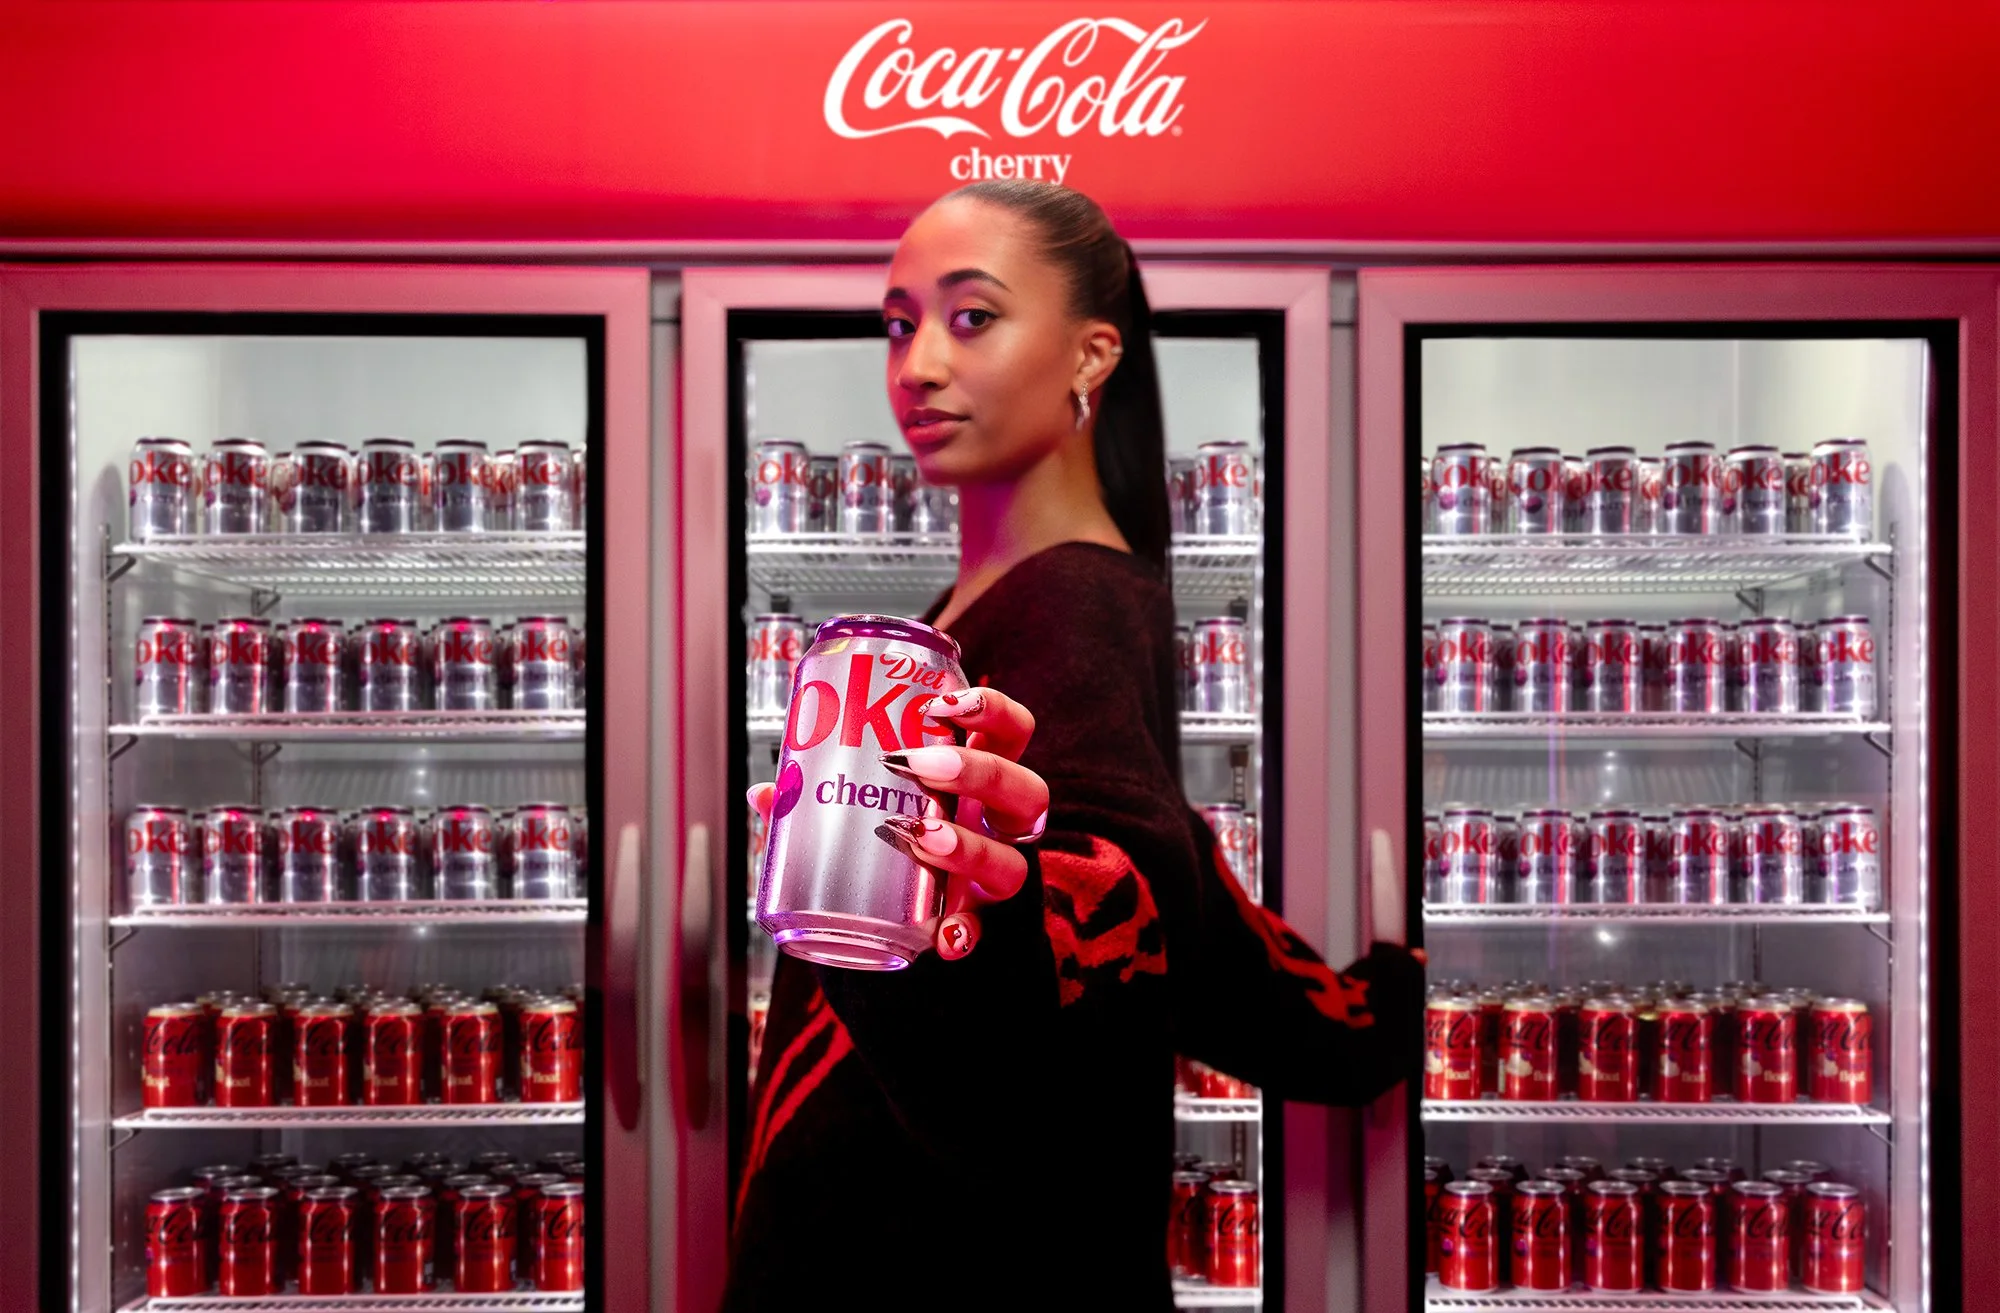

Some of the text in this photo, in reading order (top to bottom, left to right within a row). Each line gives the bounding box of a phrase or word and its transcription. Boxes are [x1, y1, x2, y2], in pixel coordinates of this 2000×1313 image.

[823, 17, 1209, 141] Coca-Cola
[950, 147, 1072, 185] cherry
[880, 652, 945, 690] Diet
[785, 654, 956, 752] oke
[816, 773, 932, 816] cherry
